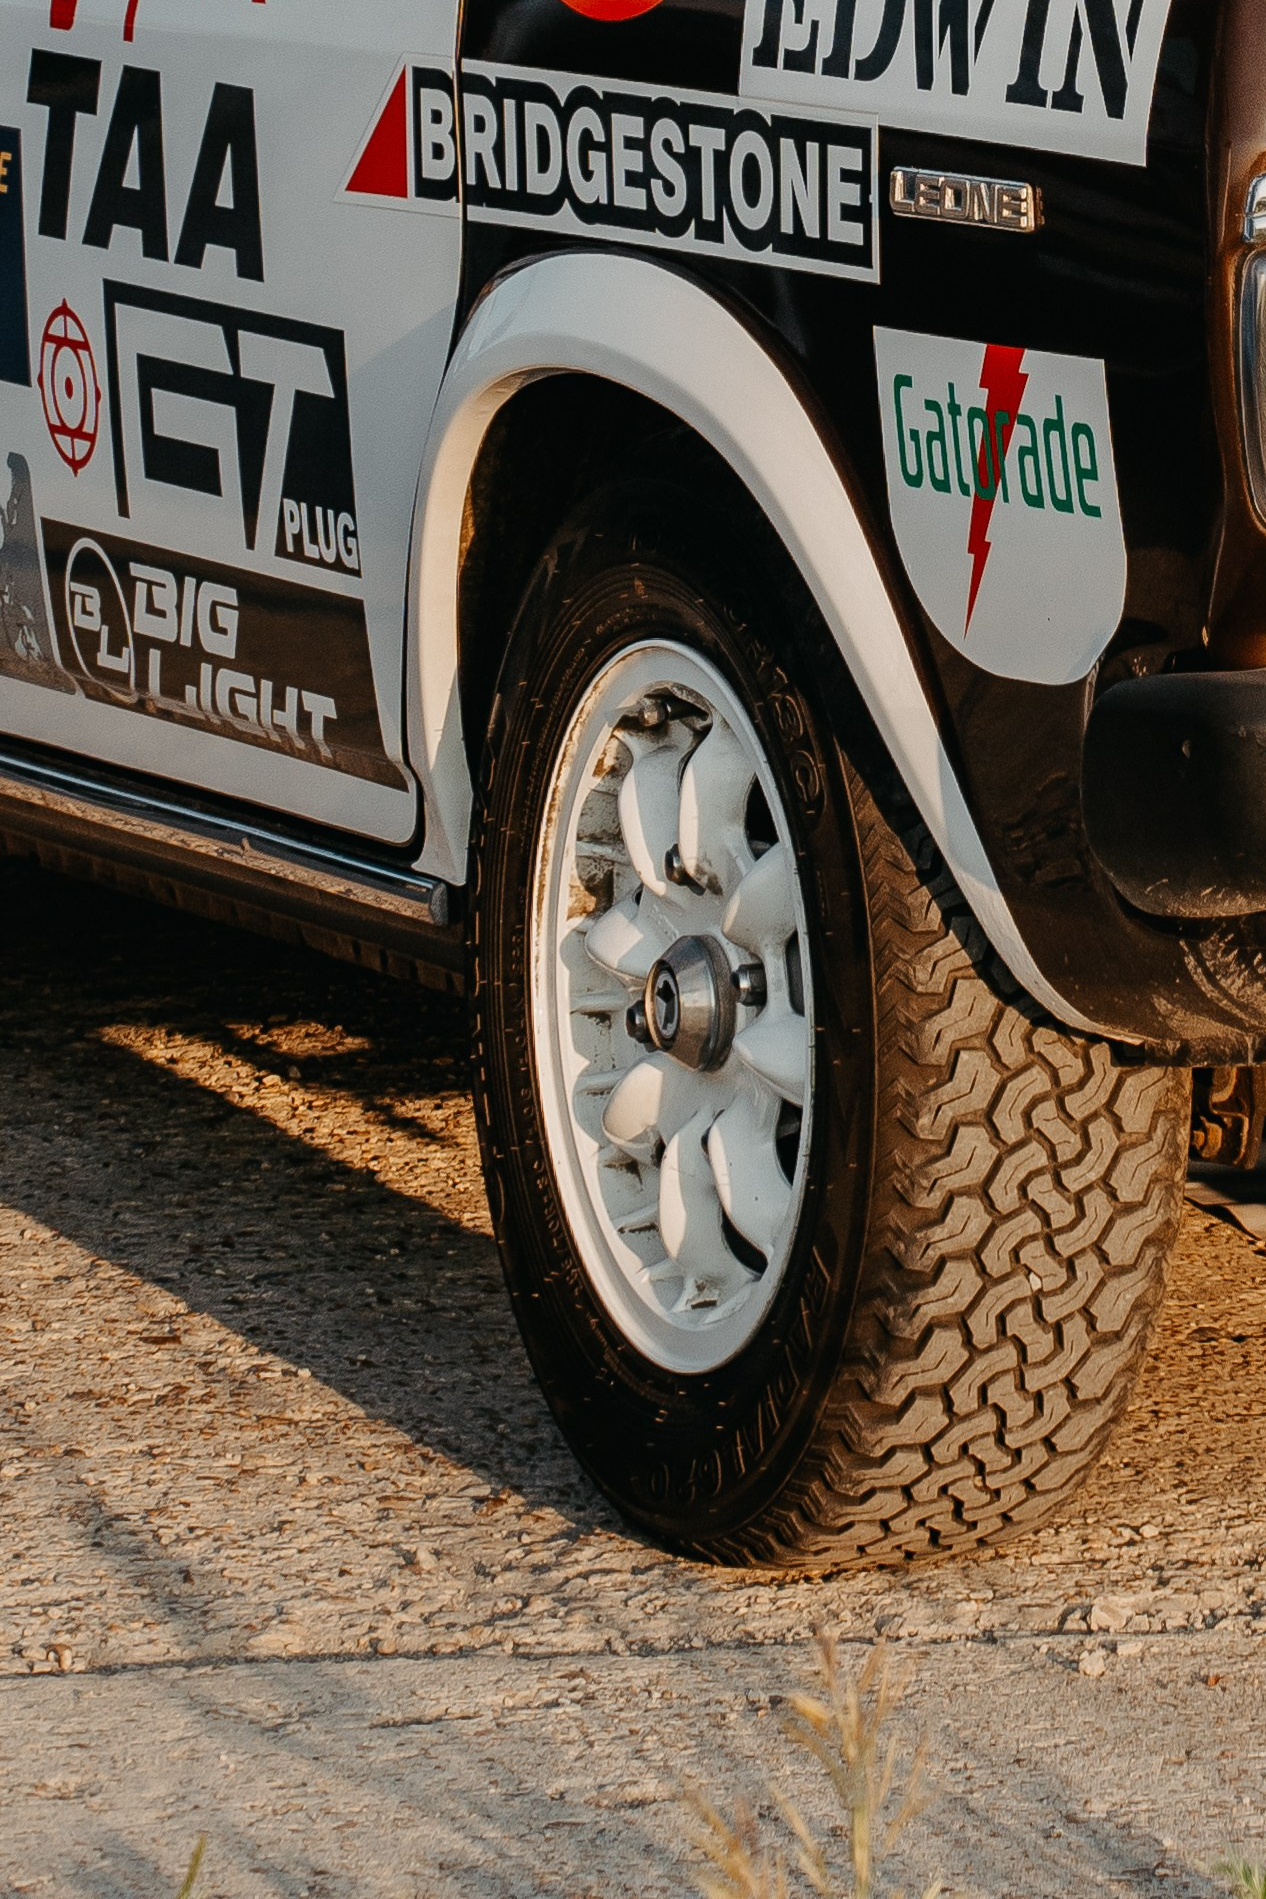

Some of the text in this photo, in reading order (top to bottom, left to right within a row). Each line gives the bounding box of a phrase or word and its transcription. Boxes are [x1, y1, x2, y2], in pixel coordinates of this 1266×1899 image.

[414, 76, 866, 251] BRIDGESTONE
[891, 169, 1030, 231] LEONE
[893, 373, 1102, 518] Gatorade
[282, 498, 360, 572] PLUG
[130, 562, 240, 660] BIG
[145, 649, 337, 759] LIGHT
